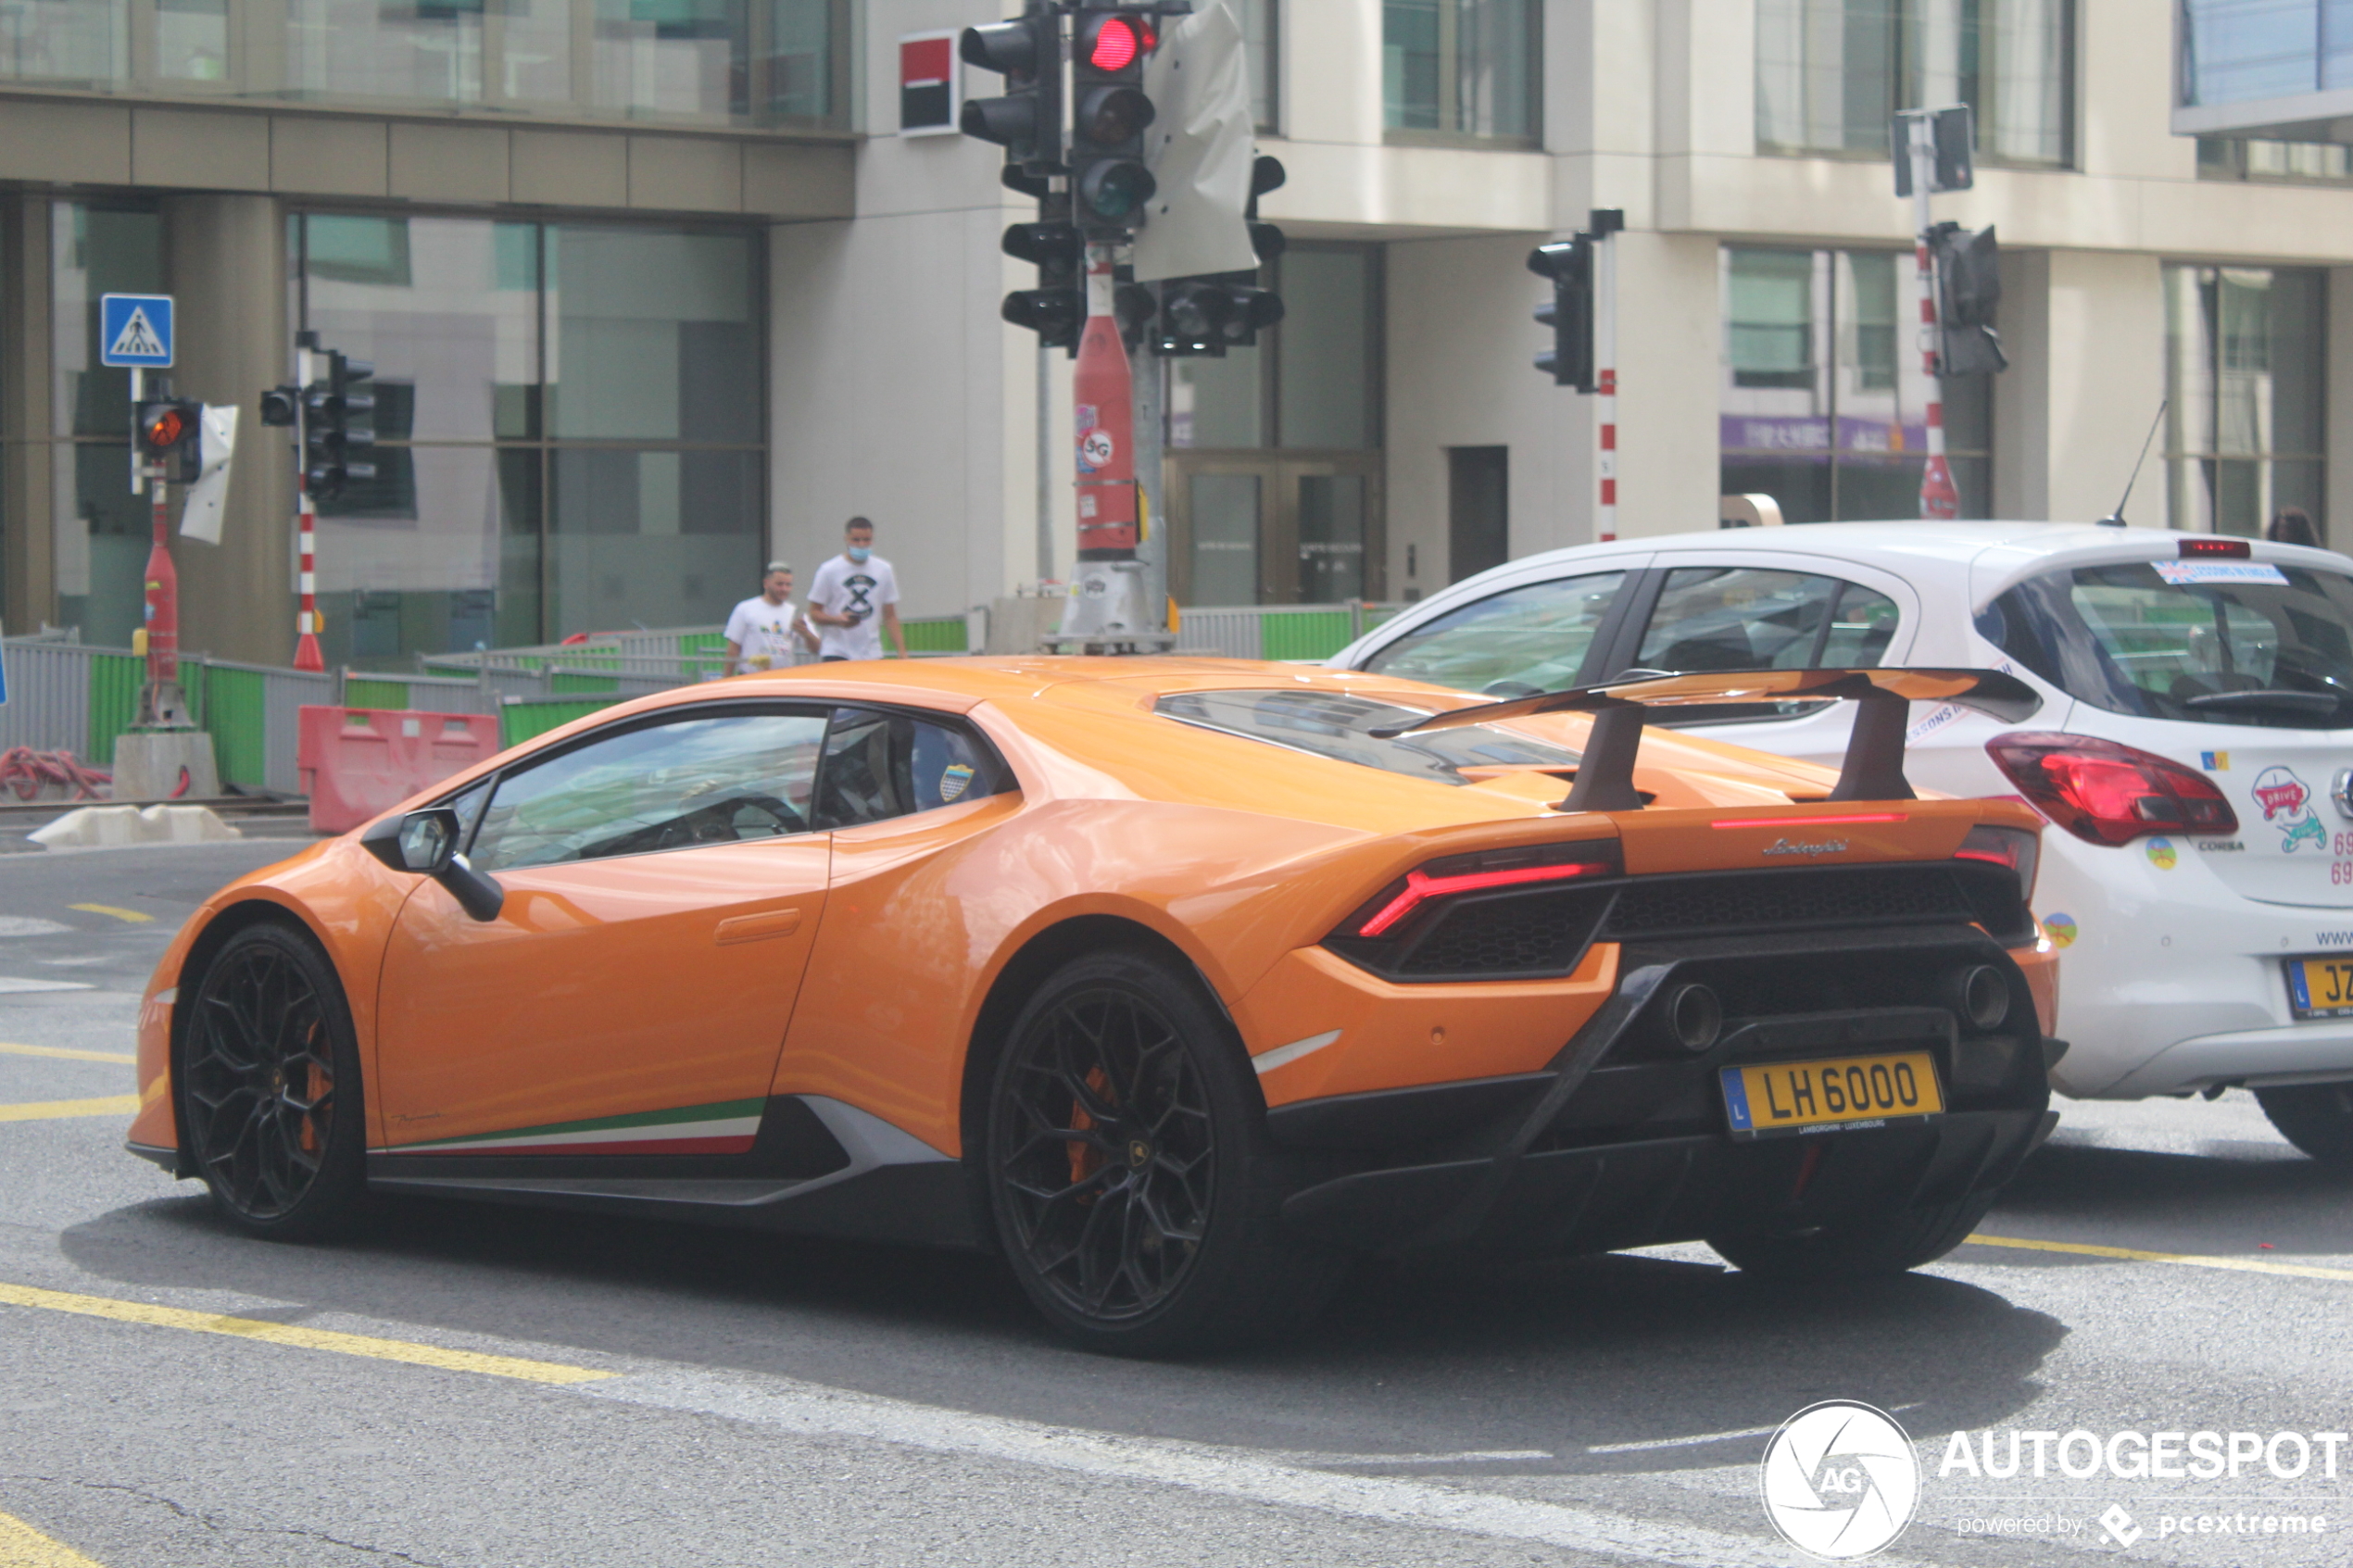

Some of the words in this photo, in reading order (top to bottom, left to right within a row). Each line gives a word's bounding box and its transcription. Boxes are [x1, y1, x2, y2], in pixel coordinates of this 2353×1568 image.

[2267, 790, 2296, 805] DRIVE
[2198, 841, 2245, 851] CORSA
[2331, 861, 2353, 884] 69
[2325, 964, 2353, 1001] JZ
[1734, 1105, 1743, 1121] L
[1763, 1062, 1918, 1120] LH6000
[1799, 1123, 1841, 1135] LAMBORGHINI
[1844, 1119, 1885, 1131] LUXEMBOURG
